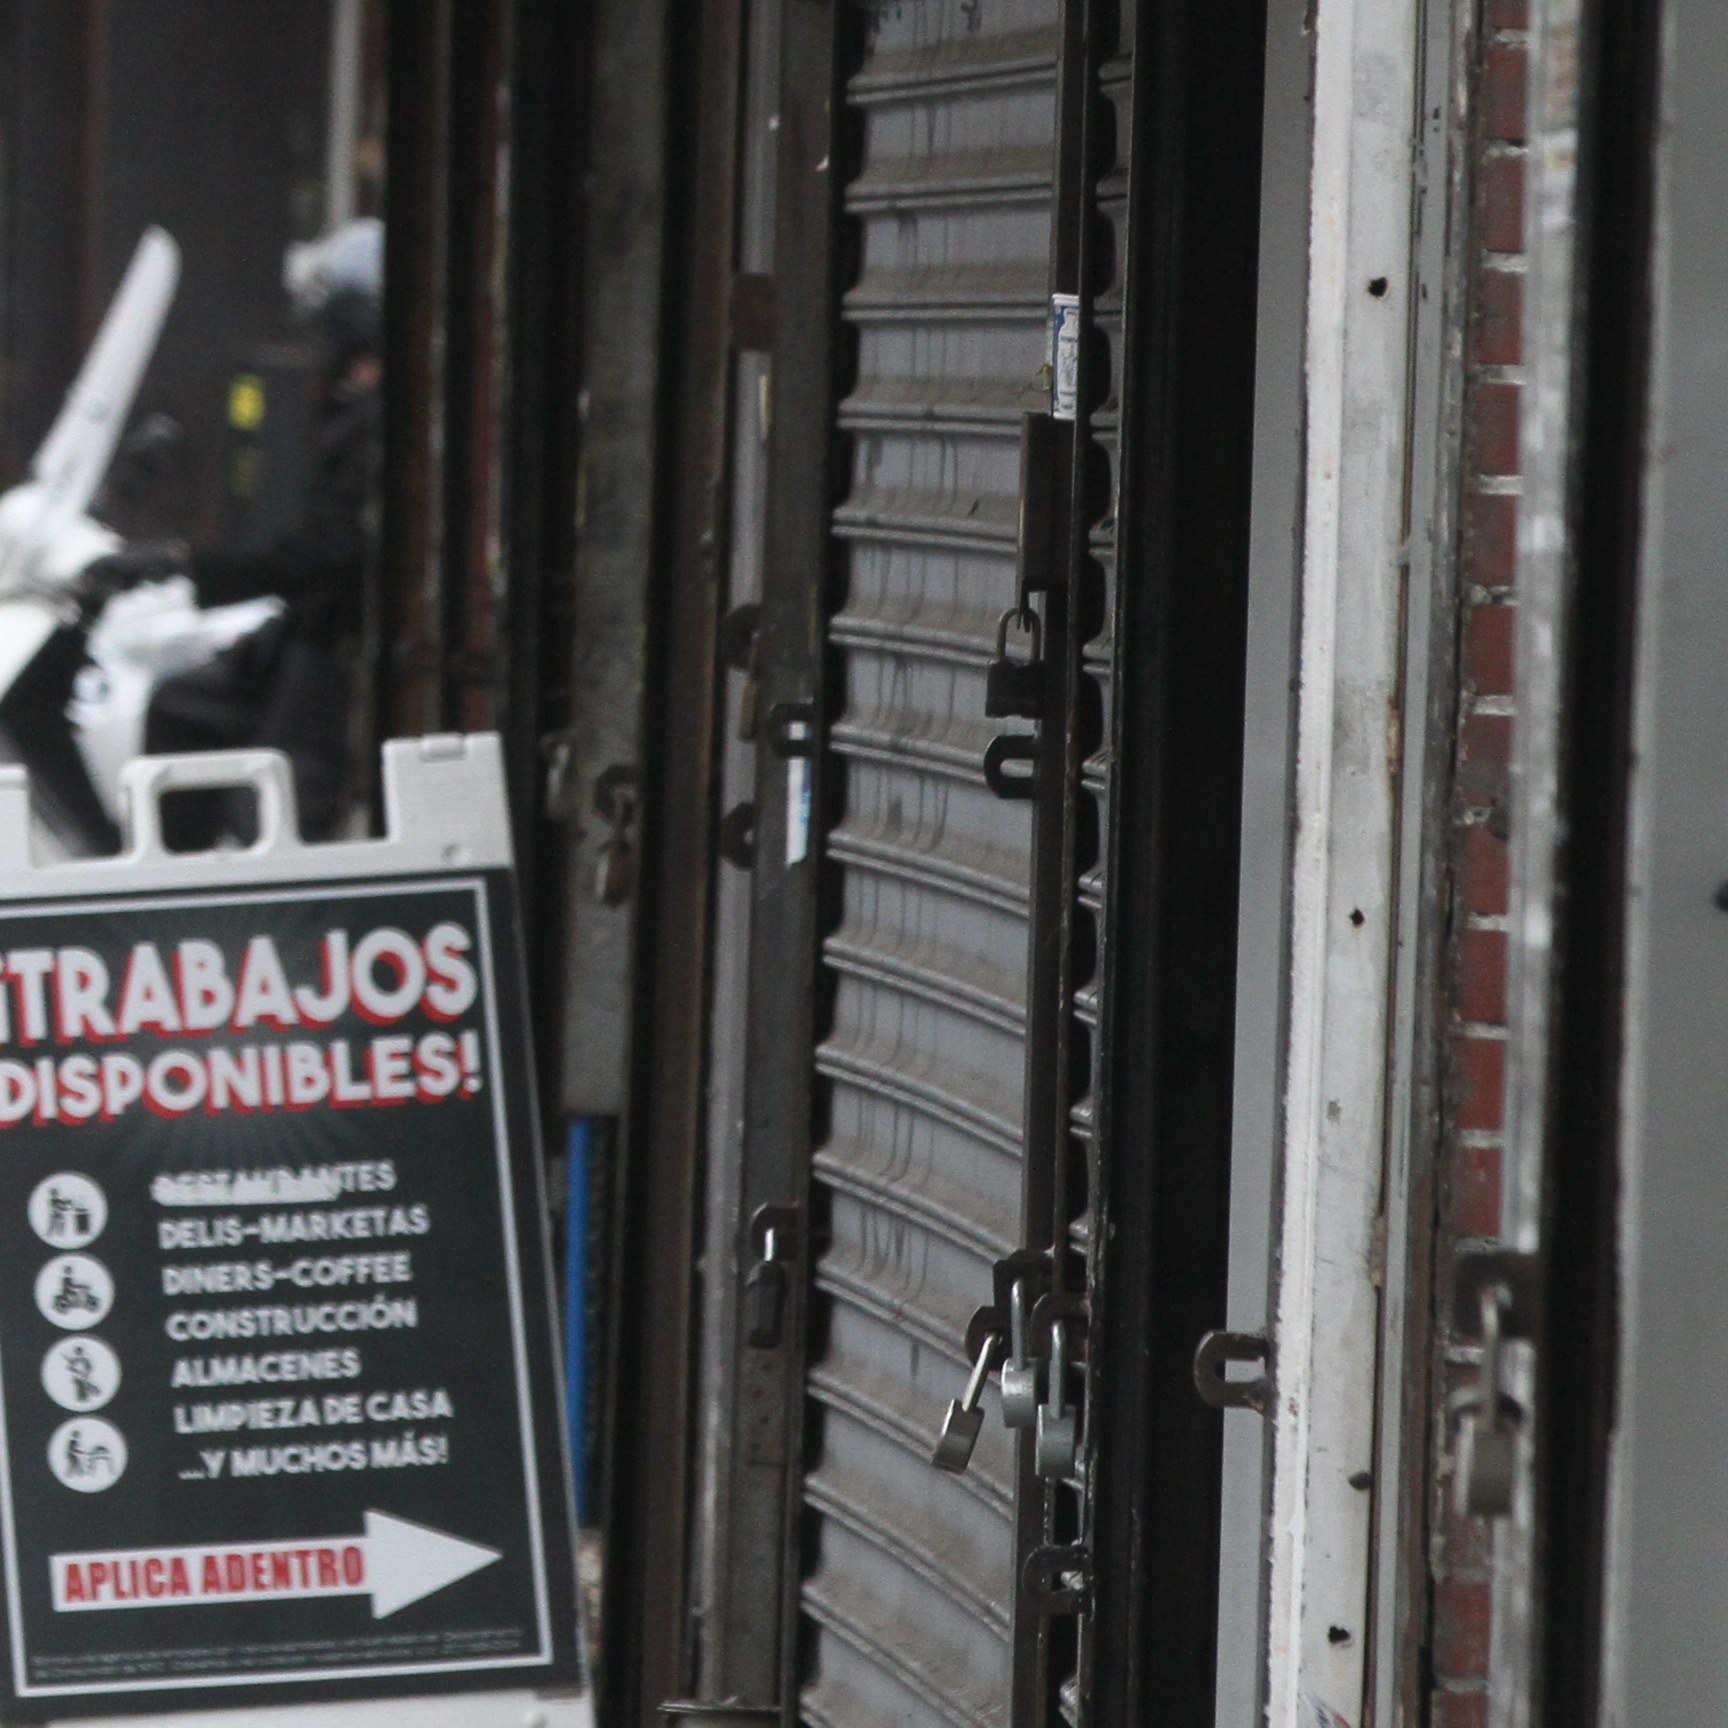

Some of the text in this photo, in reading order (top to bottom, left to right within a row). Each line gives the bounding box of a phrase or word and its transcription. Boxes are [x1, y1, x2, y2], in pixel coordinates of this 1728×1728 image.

[165, 1292, 420, 1341] CONSTRUCCIÓN
[170, 1347, 363, 1389] ALMACENES
[173, 1386, 455, 1434] LIMPIEZA DE CASA
[230, 1441, 368, 1477] MUCHOS
[369, 1428, 450, 1469] MÁS!
[63, 1545, 368, 1604] APLICA ADENTRO
